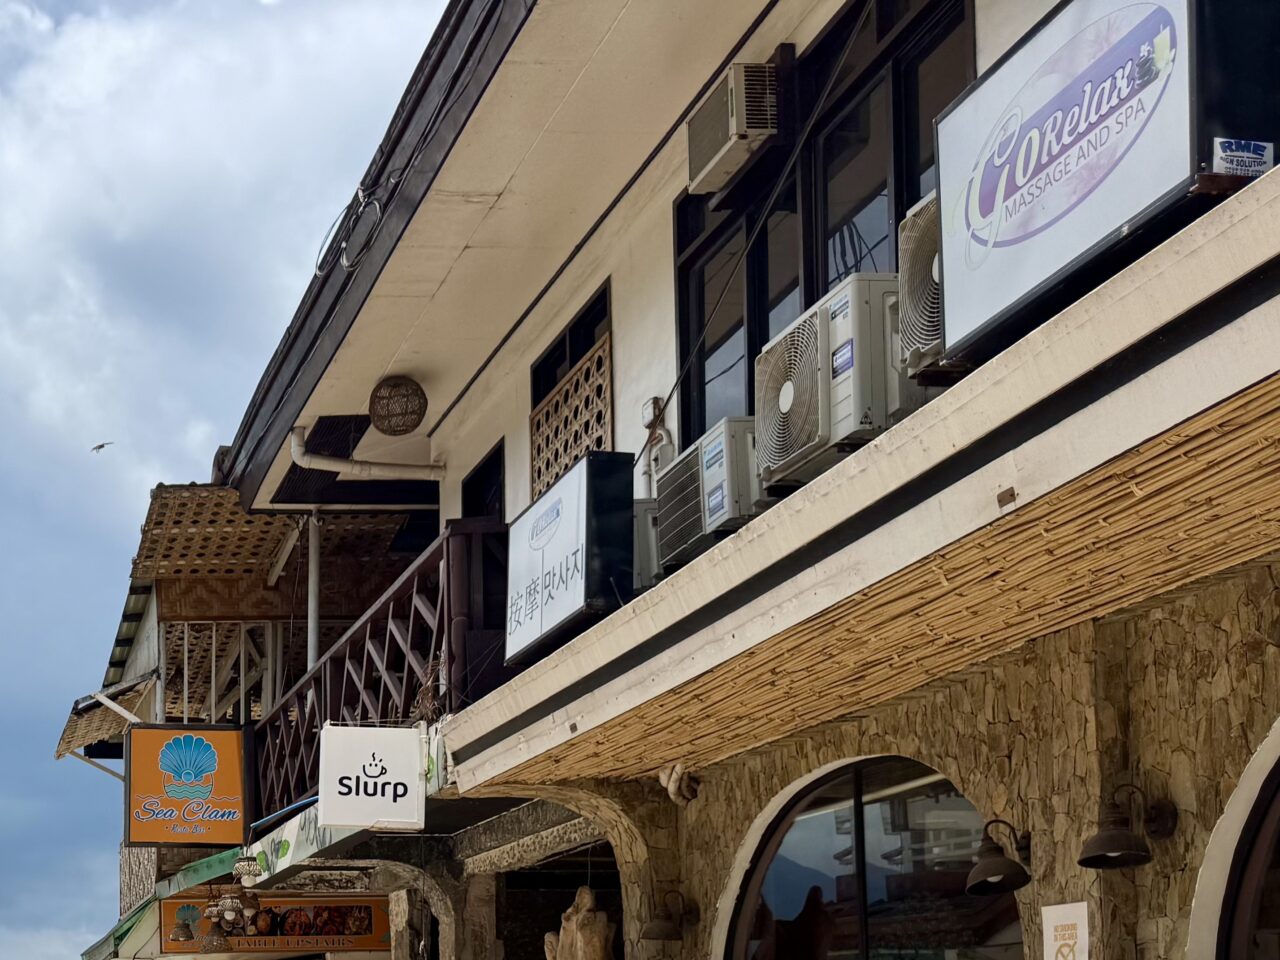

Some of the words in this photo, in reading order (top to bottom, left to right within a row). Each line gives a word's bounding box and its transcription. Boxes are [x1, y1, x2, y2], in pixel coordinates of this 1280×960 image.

[1004, 159, 1073, 223] MASSAGE
[1075, 125, 1110, 168] AND
[1115, 97, 1146, 135] SPA
[1219, 140, 1267, 158] RME
[544, 543, 584, 606] 맛사지
[508, 576, 540, 636] 按摩
[134, 800, 178, 821] Sea
[182, 800, 240, 821] Clam
[337, 775, 408, 803] Slurp
